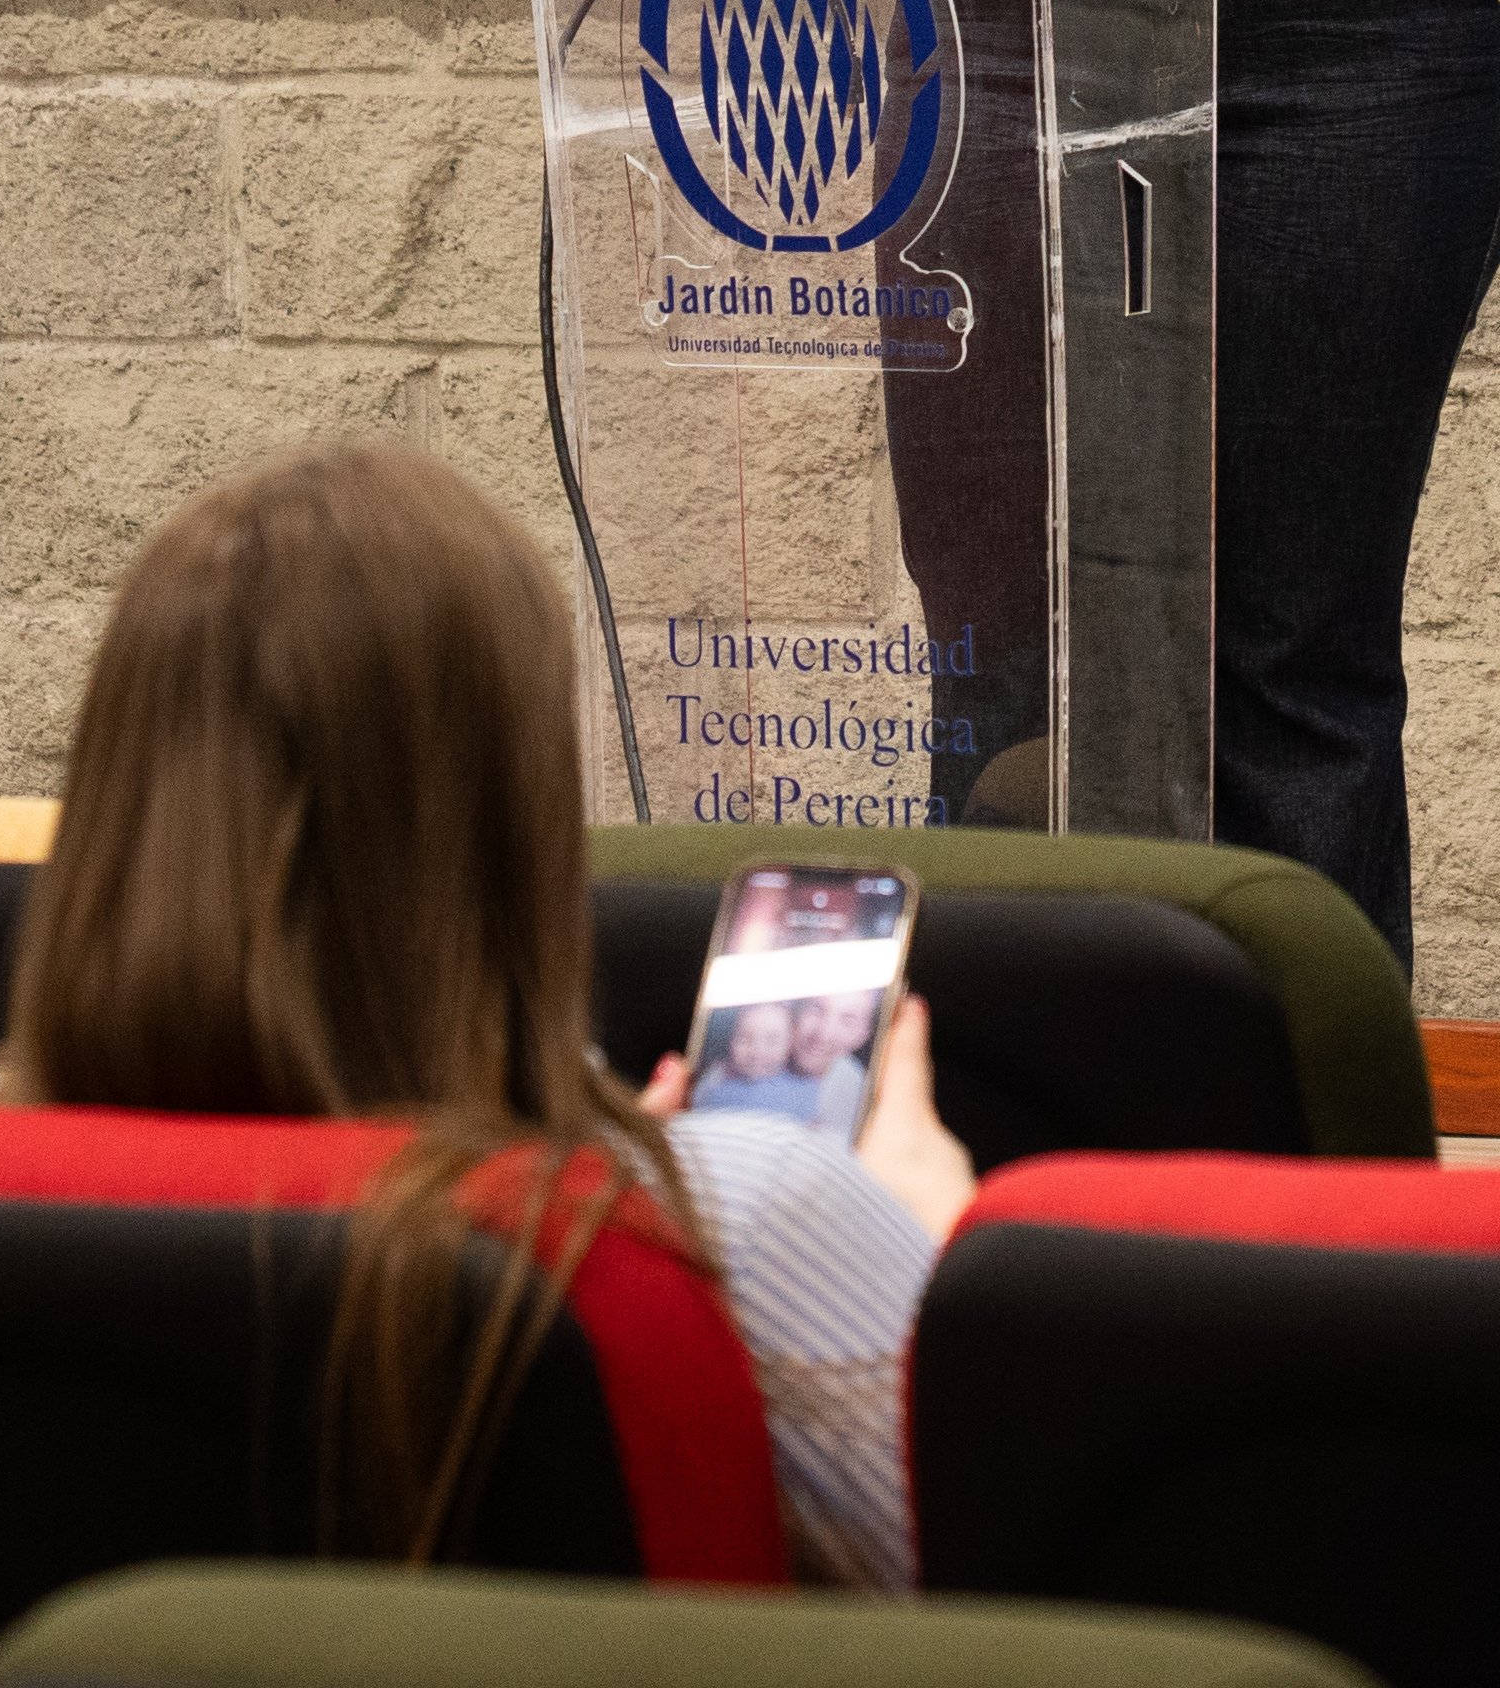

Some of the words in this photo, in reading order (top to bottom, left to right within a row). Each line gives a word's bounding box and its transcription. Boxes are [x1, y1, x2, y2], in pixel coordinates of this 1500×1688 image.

[658, 274, 773, 316] Jardín
[789, 276, 952, 320] Botánico
[668, 335, 761, 355] Universidad
[863, 339, 883, 358] de
[666, 616, 978, 678] Universidad
[665, 693, 978, 768] Tecnológica
[693, 771, 751, 826] de
[771, 774, 948, 829] Pereira
